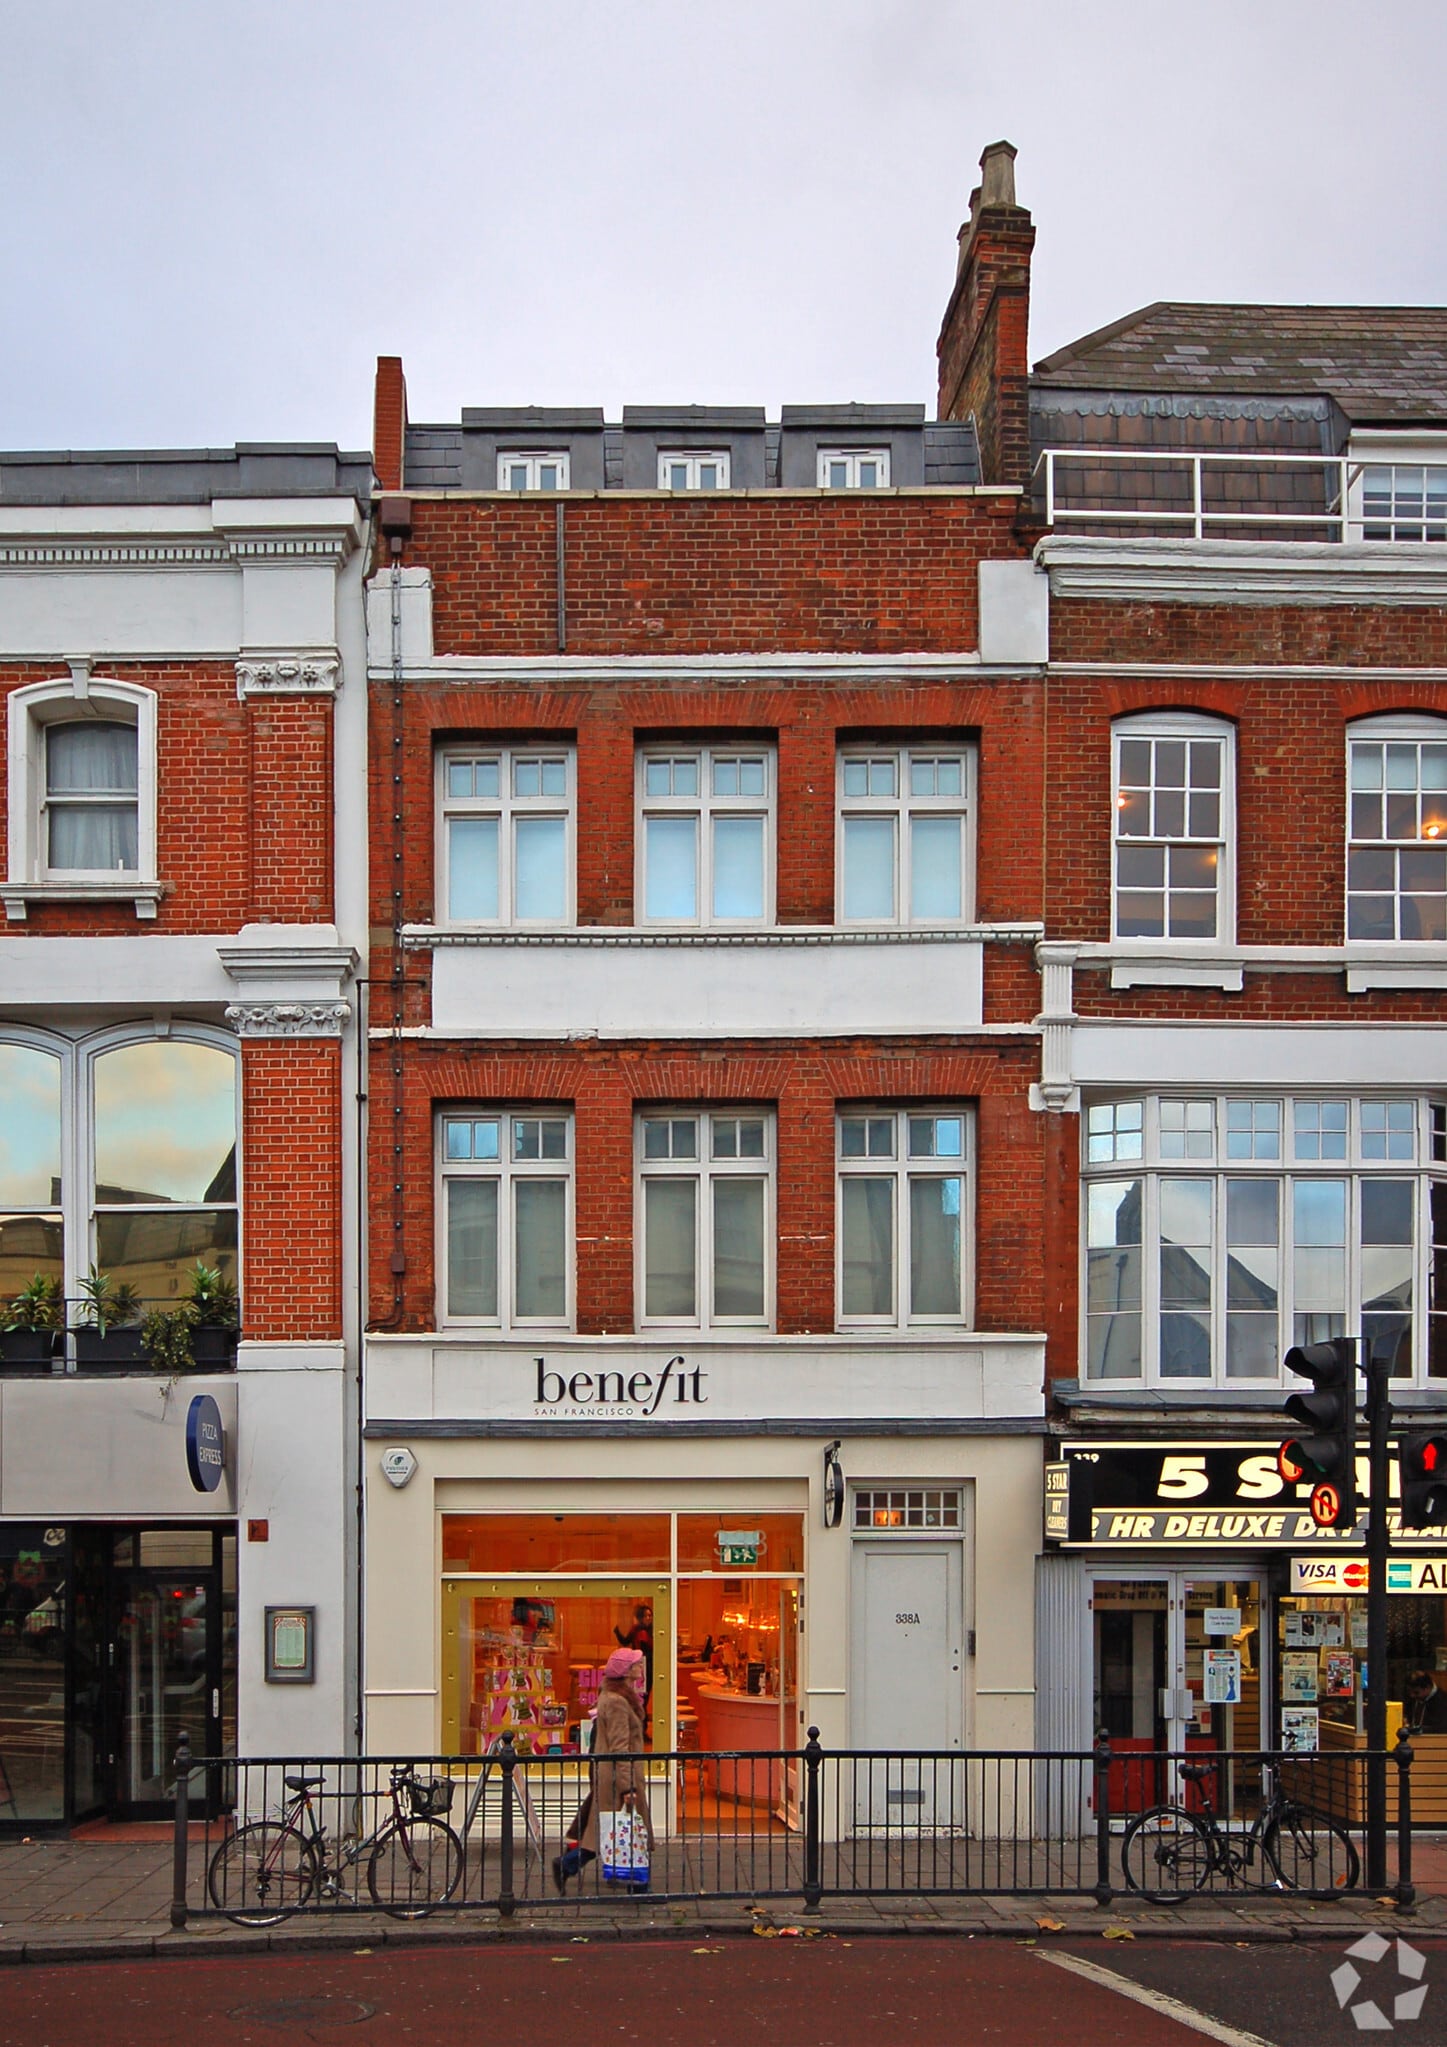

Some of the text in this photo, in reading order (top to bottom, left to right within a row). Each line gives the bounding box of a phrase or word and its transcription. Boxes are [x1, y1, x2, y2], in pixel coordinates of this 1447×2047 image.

[533, 1356, 709, 1415] benefit
[534, 1408, 634, 1416] SAN FRANCISCO
[202, 1422, 218, 1440] PIZZA
[199, 1446, 222, 1465] EXPRESS
[1157, 1456, 1209, 1499] 5
[1109, 1515, 1155, 1537] HR
[1163, 1515, 1286, 1538] DELUXE
[1297, 1564, 1337, 1577] VISA
[895, 1613, 920, 1624] 338A
